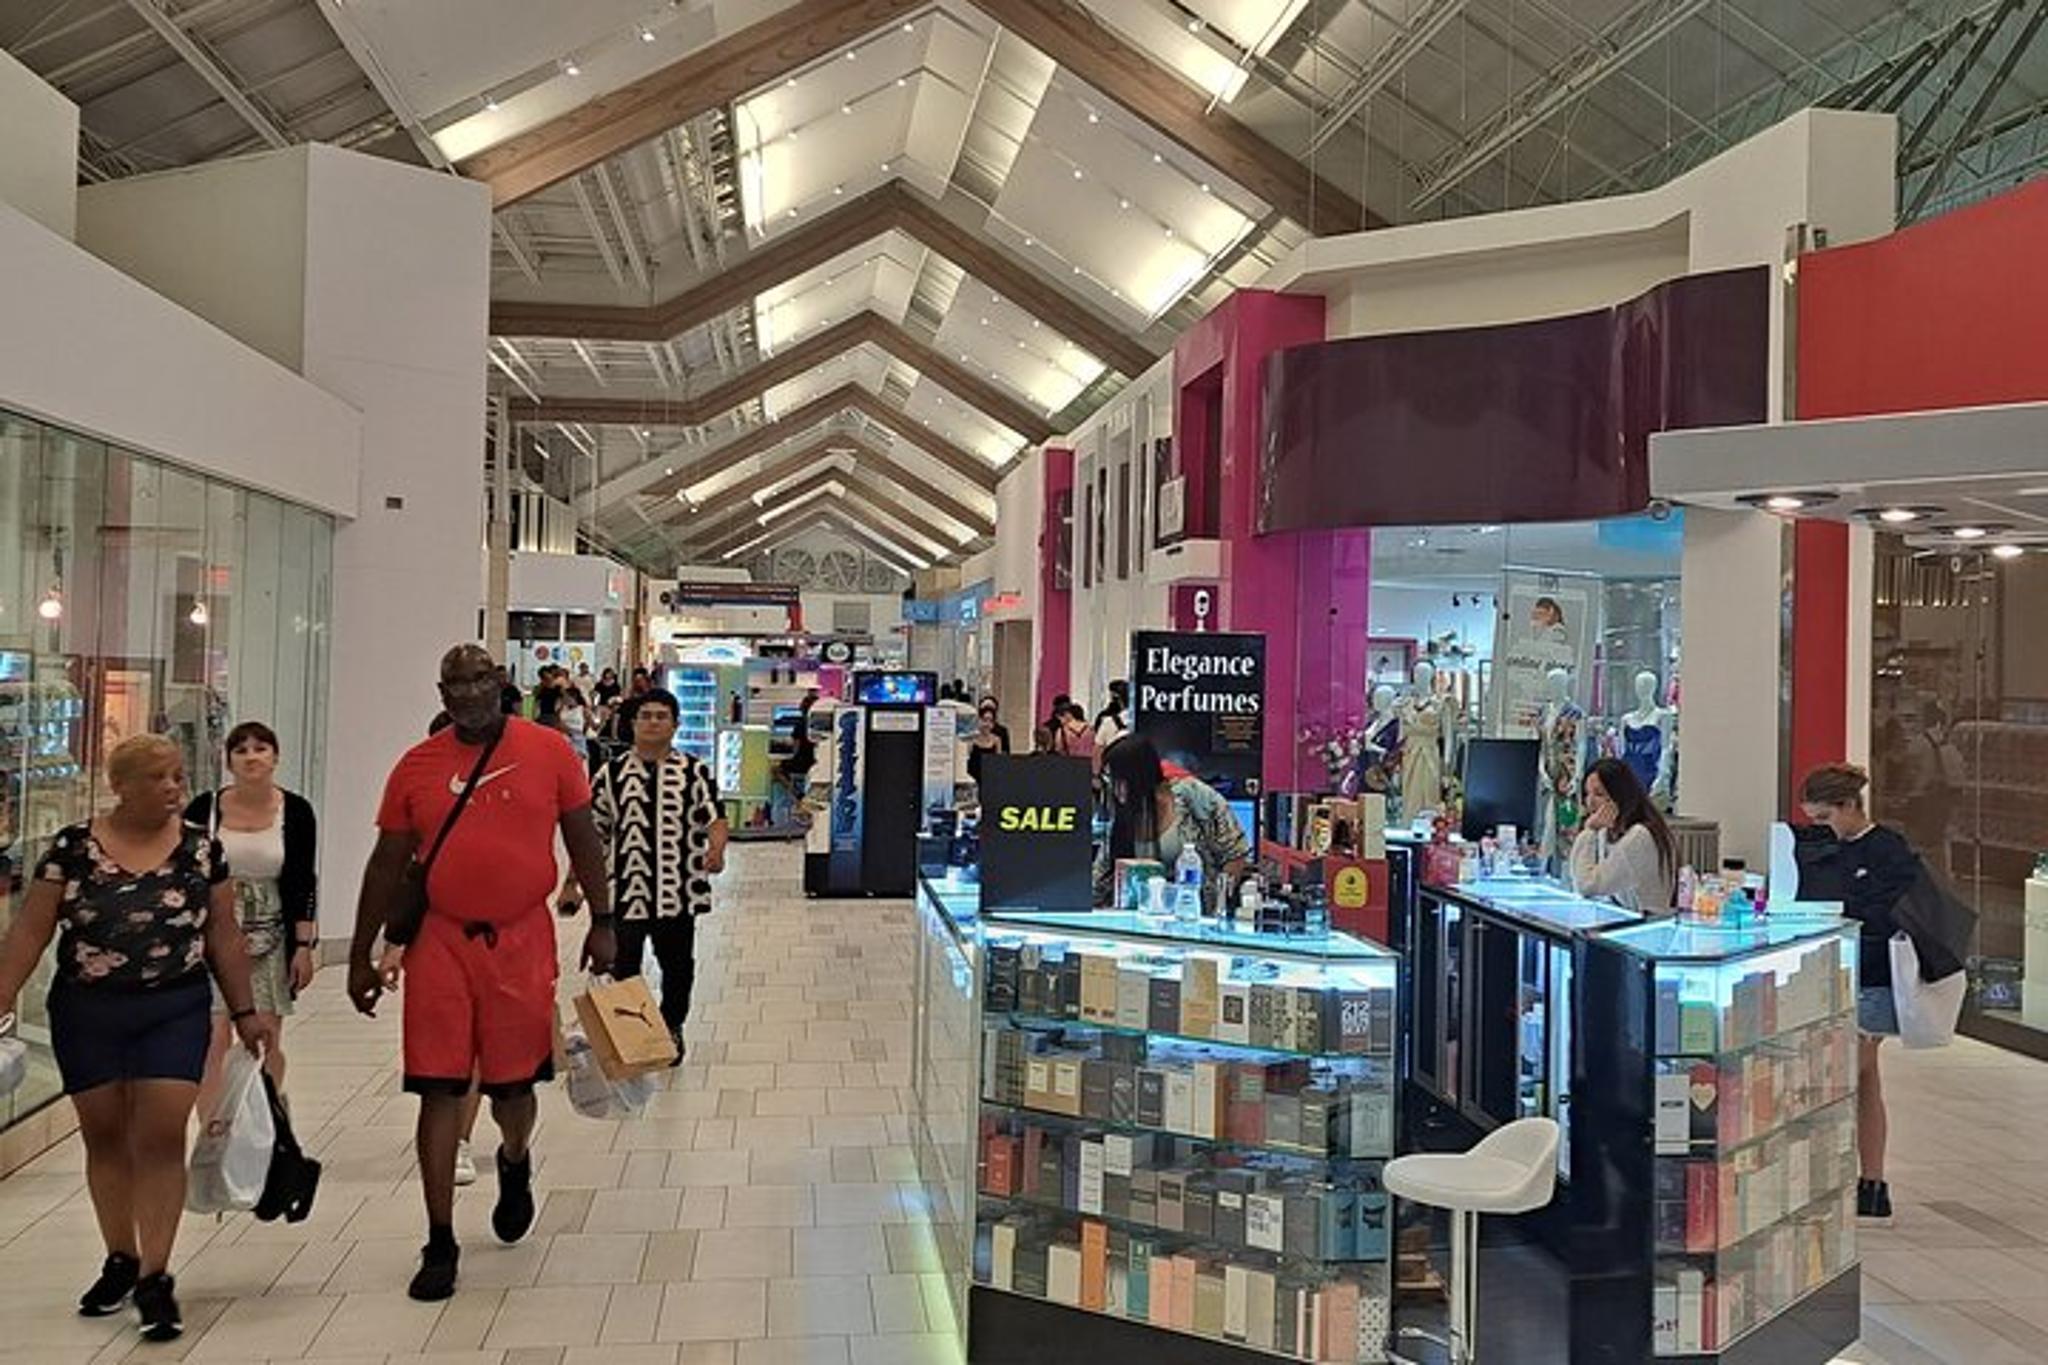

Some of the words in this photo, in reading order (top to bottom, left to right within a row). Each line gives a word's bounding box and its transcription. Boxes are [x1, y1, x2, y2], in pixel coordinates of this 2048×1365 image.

[1146, 646, 1255, 681] Elegance
[1140, 684, 1261, 714] Perfumes
[999, 806, 1077, 831] SALE
[1341, 999, 1371, 1016] 212
